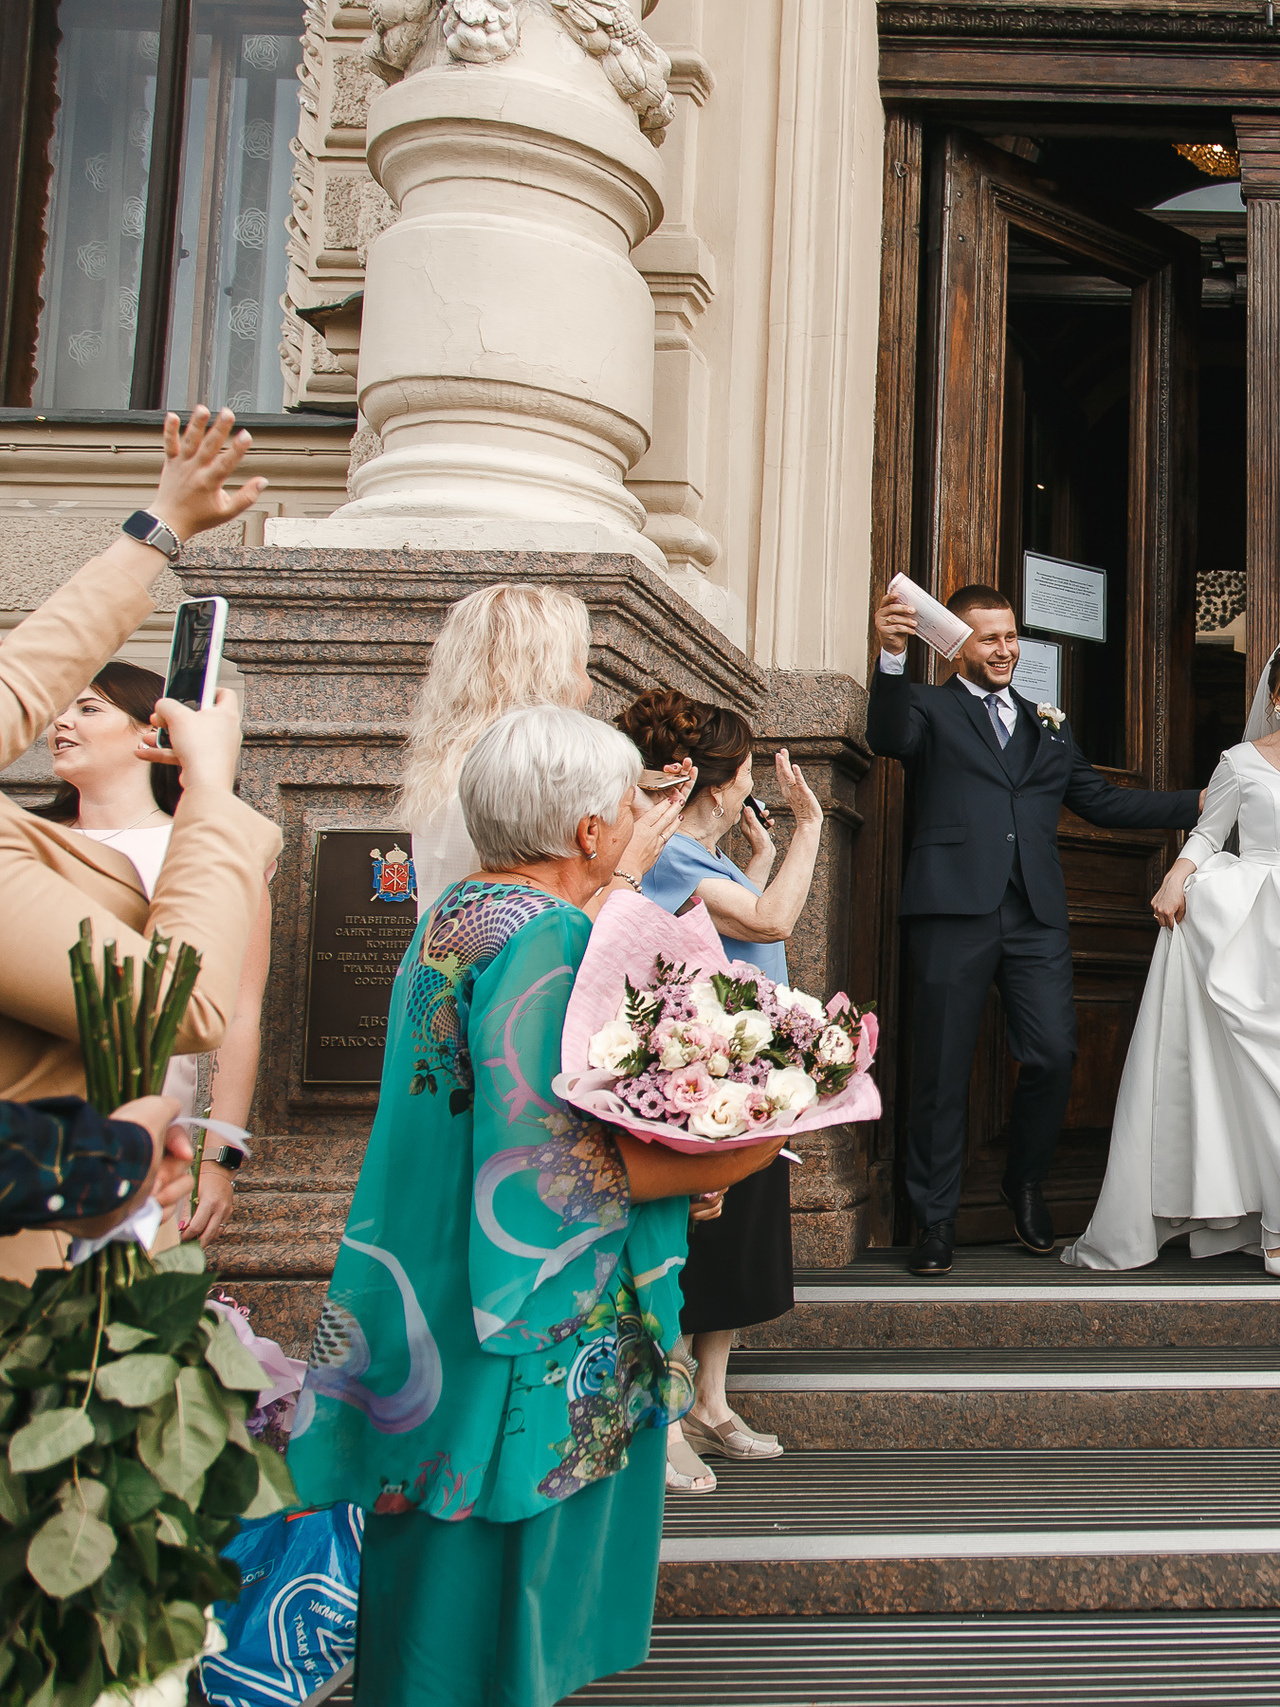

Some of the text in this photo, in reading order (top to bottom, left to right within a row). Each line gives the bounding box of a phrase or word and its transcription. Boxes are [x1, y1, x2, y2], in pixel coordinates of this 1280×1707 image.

[335, 928, 415, 937] САНКТ-ПЕТЕР
[316, 951, 333, 961] ПО
[337, 952, 379, 962] ДЕЛАМ
[354, 977, 394, 986] СОСТО
